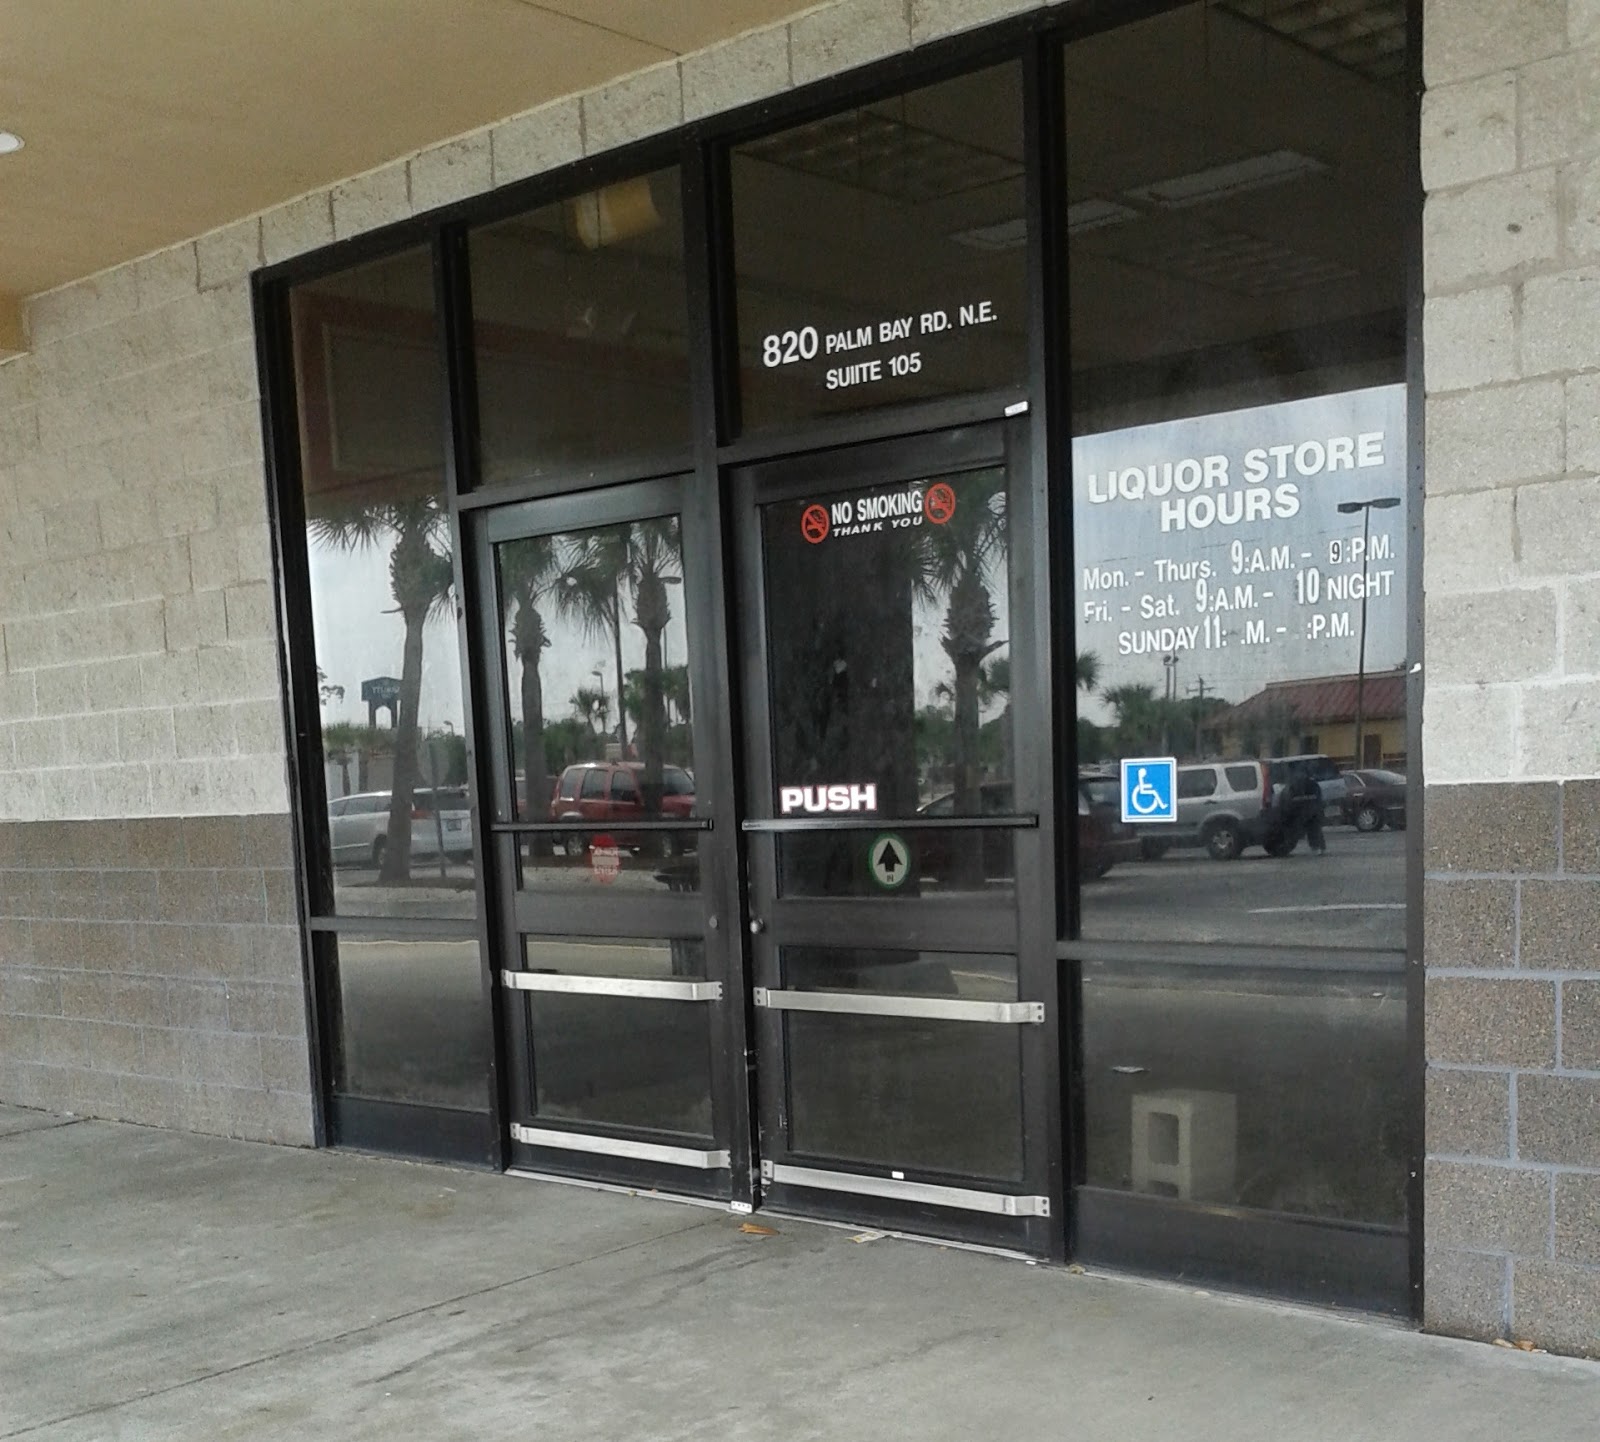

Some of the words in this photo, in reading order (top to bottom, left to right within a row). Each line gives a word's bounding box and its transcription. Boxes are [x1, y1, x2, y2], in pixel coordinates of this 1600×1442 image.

[763, 326, 819, 368] 820
[825, 326, 873, 355] PALM
[879, 317, 914, 343] BAY
[920, 310, 953, 334] RD.
[959, 300, 998, 327] N.E.
[888, 352, 923, 377] 105
[1088, 455, 1230, 503] LIQUOR
[1243, 432, 1385, 483] STORE
[831, 501, 852, 525] NO
[857, 490, 923, 522] SMOKING
[1160, 483, 1301, 532] HOURS
[833, 521, 883, 537] THANK
[892, 516, 923, 529] YOU
[1083, 567, 1130, 591] Mon.
[1153, 559, 1217, 583] Thurs.
[1083, 600, 1113, 622] Fri.
[1140, 594, 1181, 619] Sat.
[1296, 567, 1320, 605] 10
[1327, 570, 1395, 601] NIGHT
[1118, 625, 1199, 655] SUNDAY
[780, 783, 877, 815] PUSH
